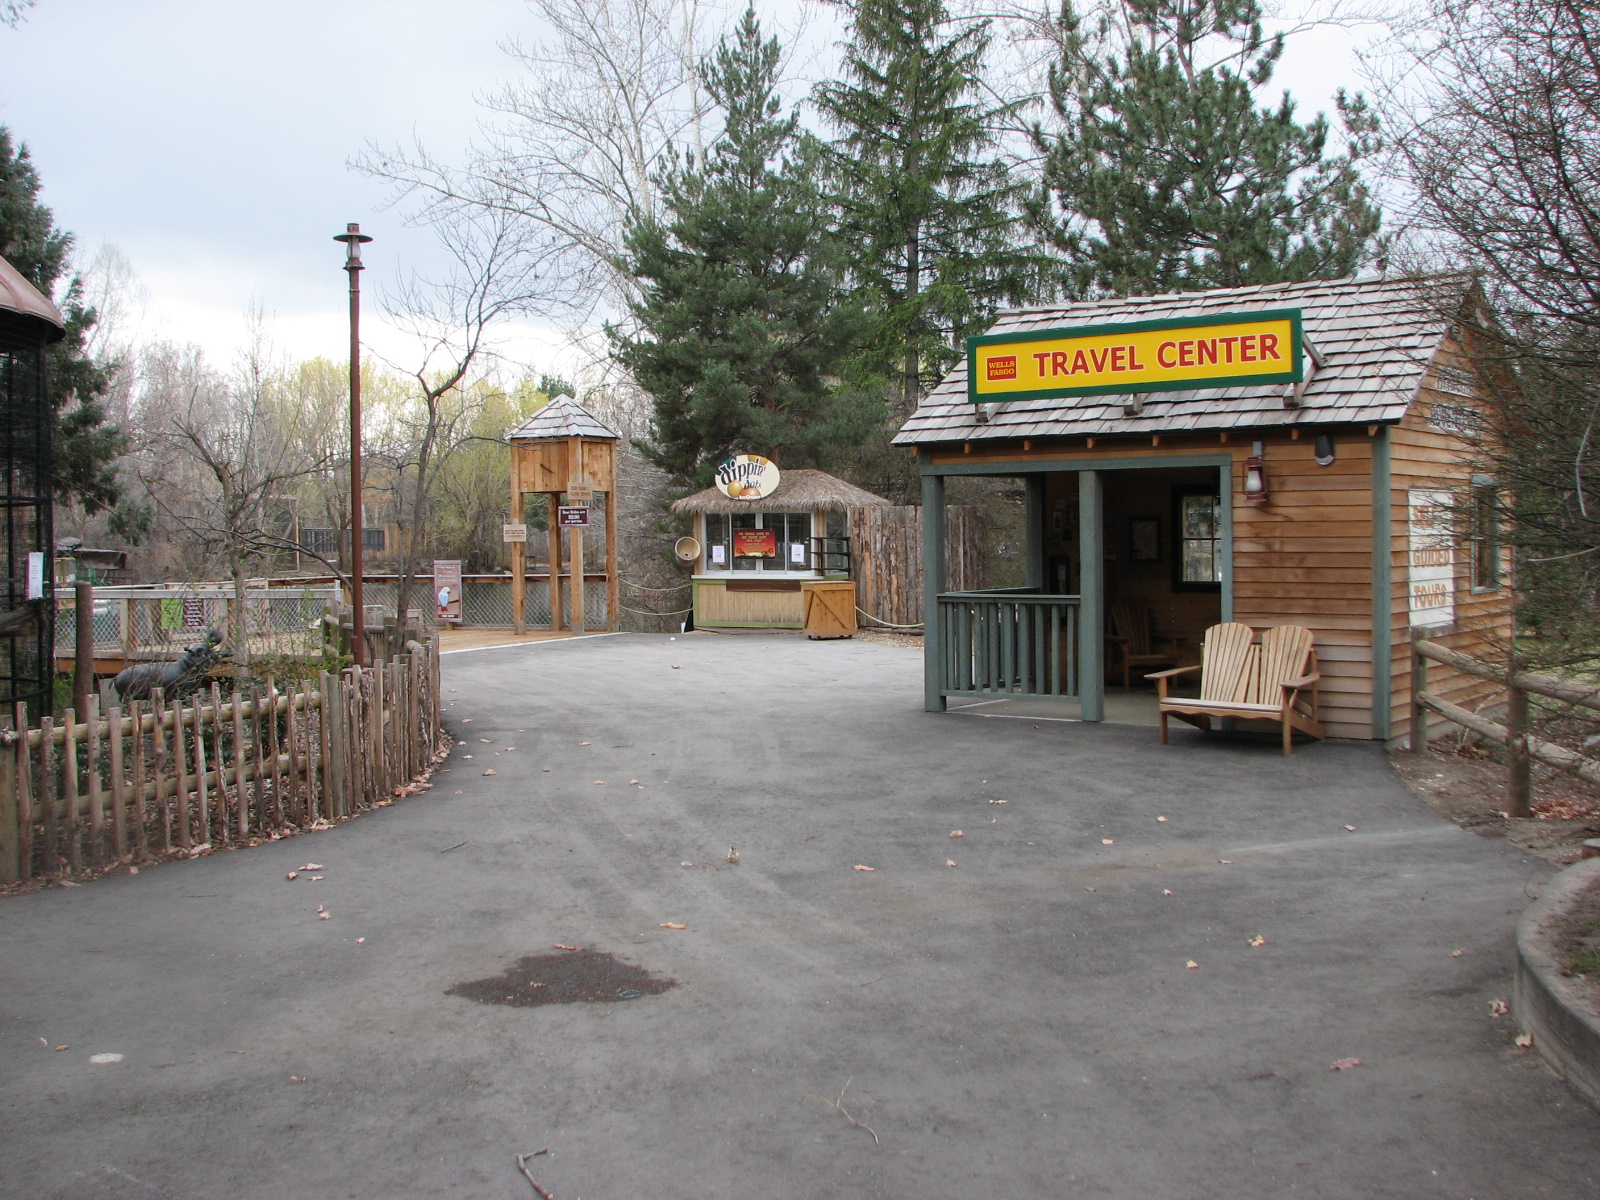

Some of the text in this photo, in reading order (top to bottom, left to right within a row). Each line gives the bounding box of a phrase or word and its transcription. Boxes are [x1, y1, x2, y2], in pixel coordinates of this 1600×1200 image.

[988, 360, 1015, 369] WELLS
[1033, 333, 1282, 377] TRAVEL CENTER
[990, 368, 1015, 376] FARGO
[1413, 545, 1451, 568] GUIDED
[1413, 583, 1448, 609] TOURS
